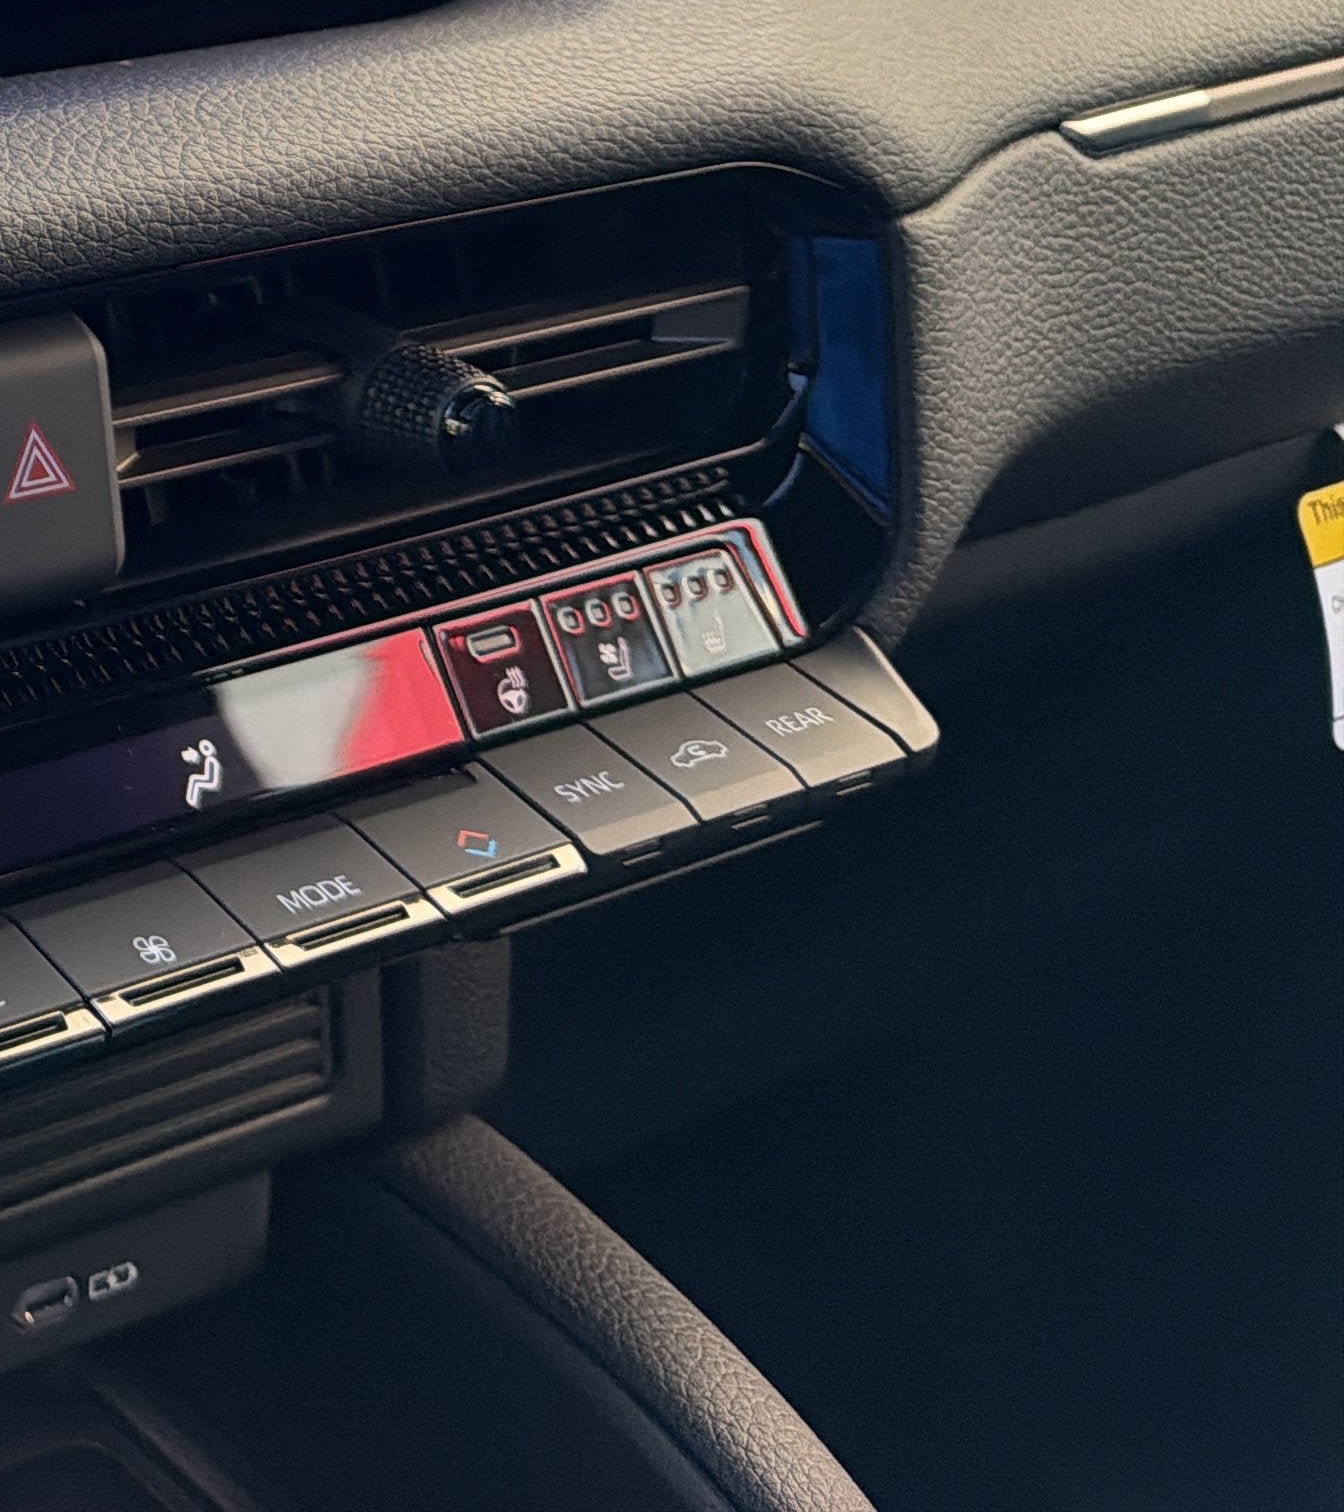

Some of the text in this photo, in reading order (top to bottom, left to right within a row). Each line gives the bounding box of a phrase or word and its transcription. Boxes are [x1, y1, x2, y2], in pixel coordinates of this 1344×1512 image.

[764, 705, 835, 738] REAR
[553, 770, 625, 805] SYNC
[276, 873, 362, 916] MODE
